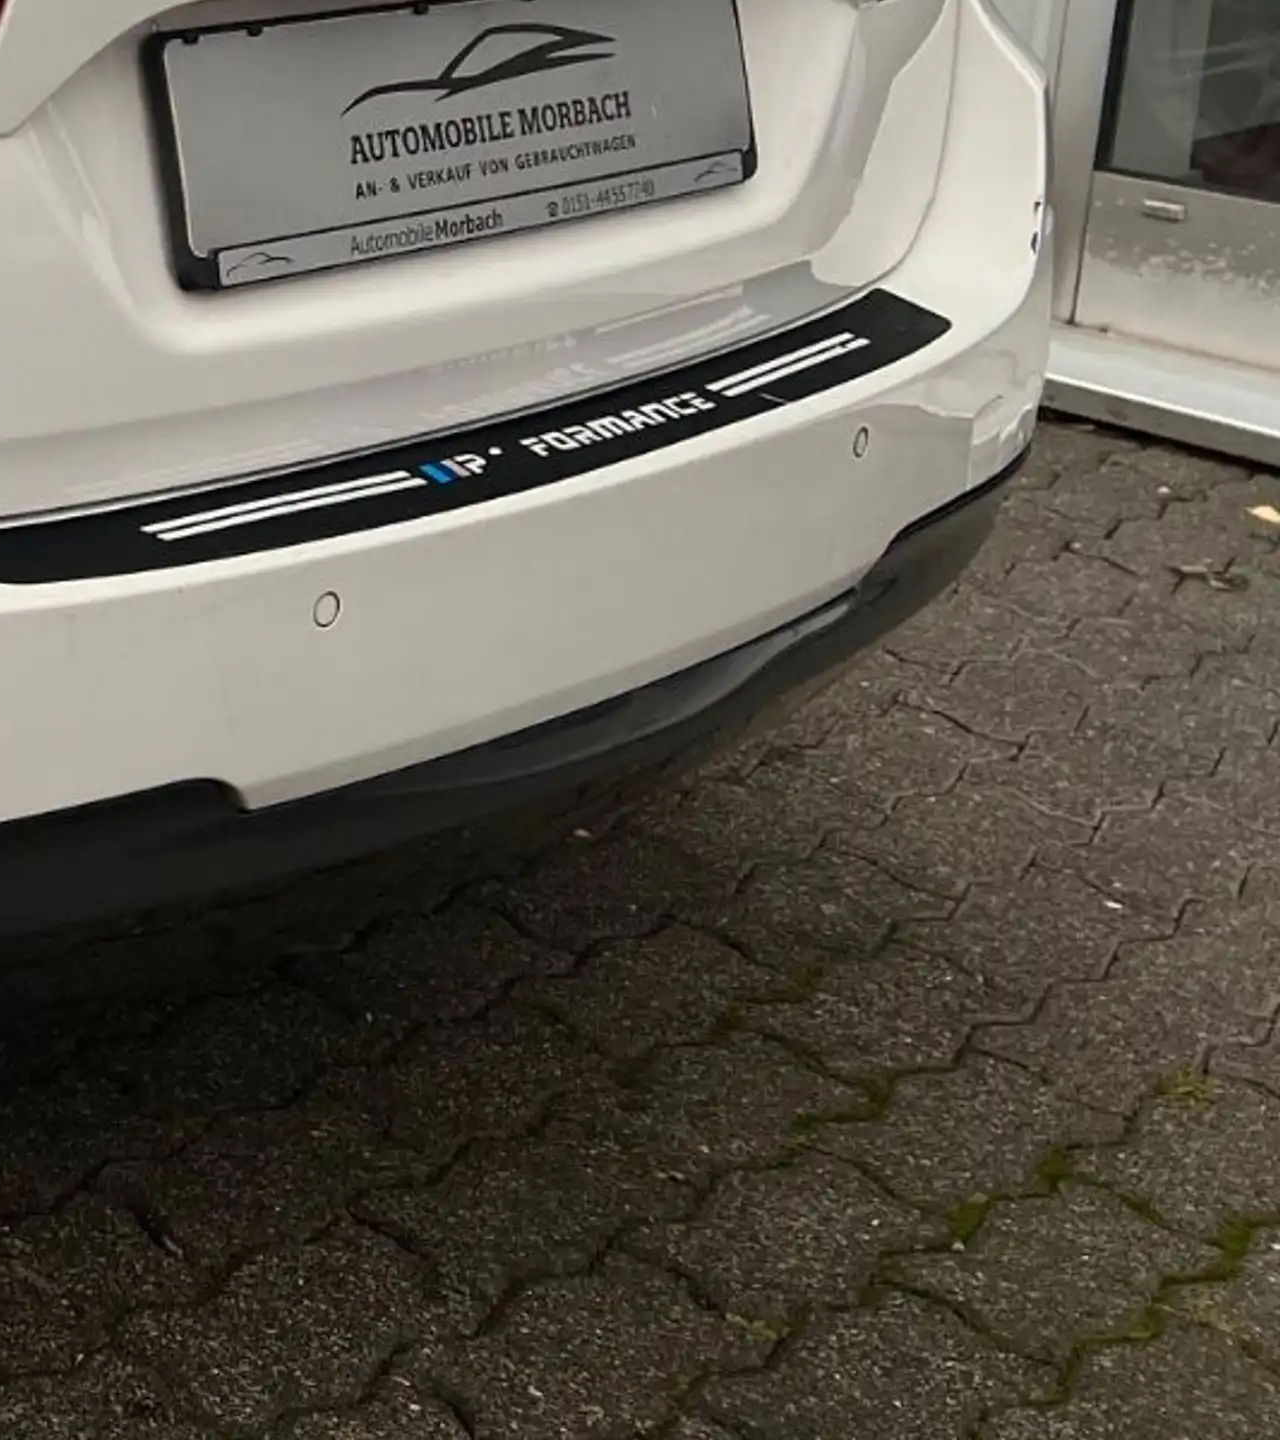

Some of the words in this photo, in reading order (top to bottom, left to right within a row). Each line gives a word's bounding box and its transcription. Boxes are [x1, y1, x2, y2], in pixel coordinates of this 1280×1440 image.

[349, 111, 515, 165] AUTOMOBILE
[517, 90, 631, 137] MORBACH
[406, 163, 476, 190] VERKAUF
[480, 155, 510, 177] VON
[514, 133, 637, 171] GEBRAUCHTWAGEN
[519, 392, 718, 458] FORMANCE
